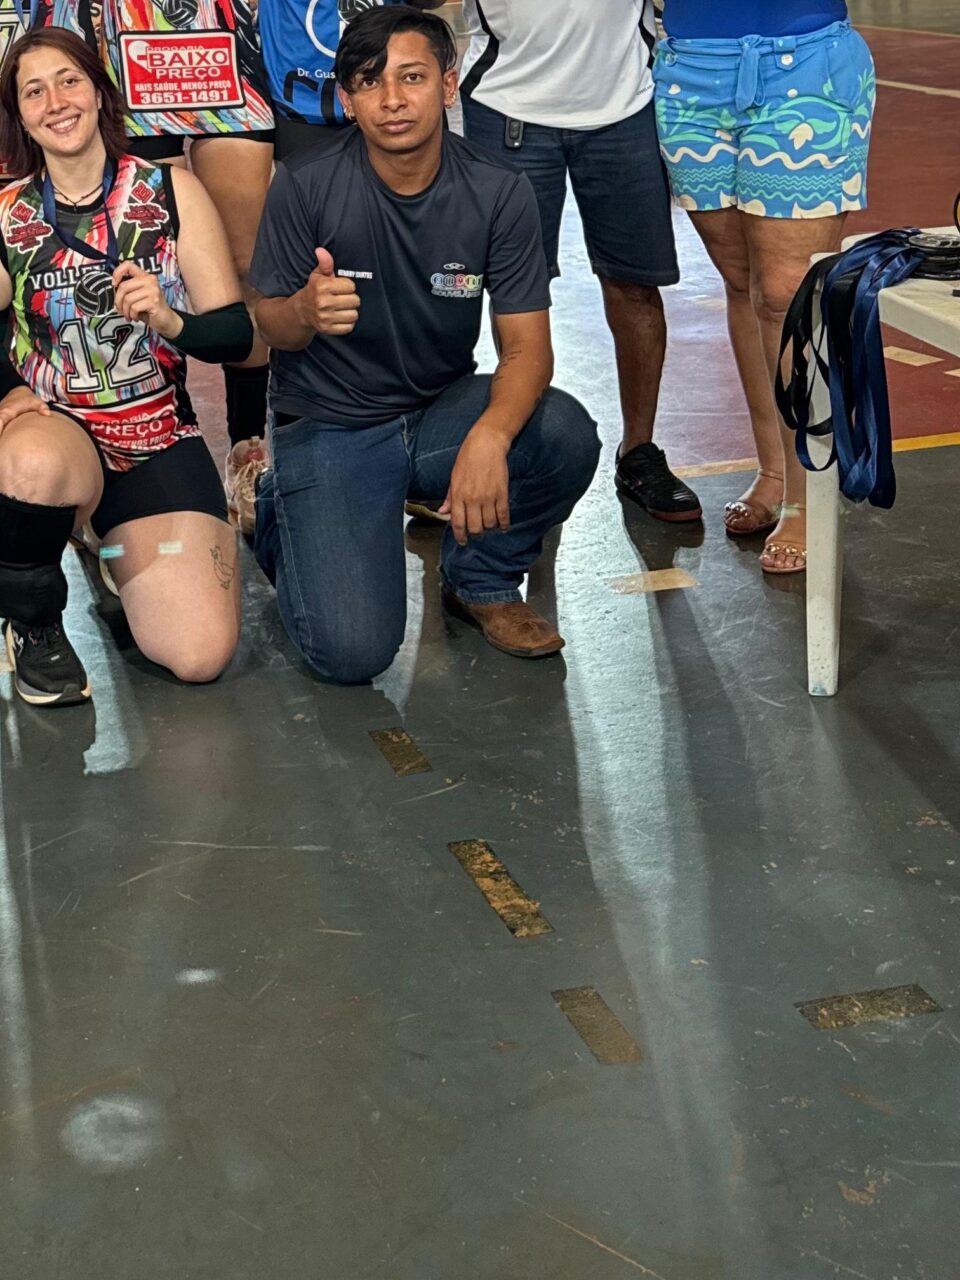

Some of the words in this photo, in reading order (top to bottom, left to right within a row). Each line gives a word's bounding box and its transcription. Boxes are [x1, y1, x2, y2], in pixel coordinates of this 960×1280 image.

[149, 50, 228, 68] BAIXO
[156, 66, 221, 80] PREÇO
[314, 68, 336, 79] Gus
[134, 82, 152, 92] MAIS
[181, 80, 208, 91] MENOS
[140, 89, 229, 104] 3651-1491
[58, 314, 159, 395] 12
